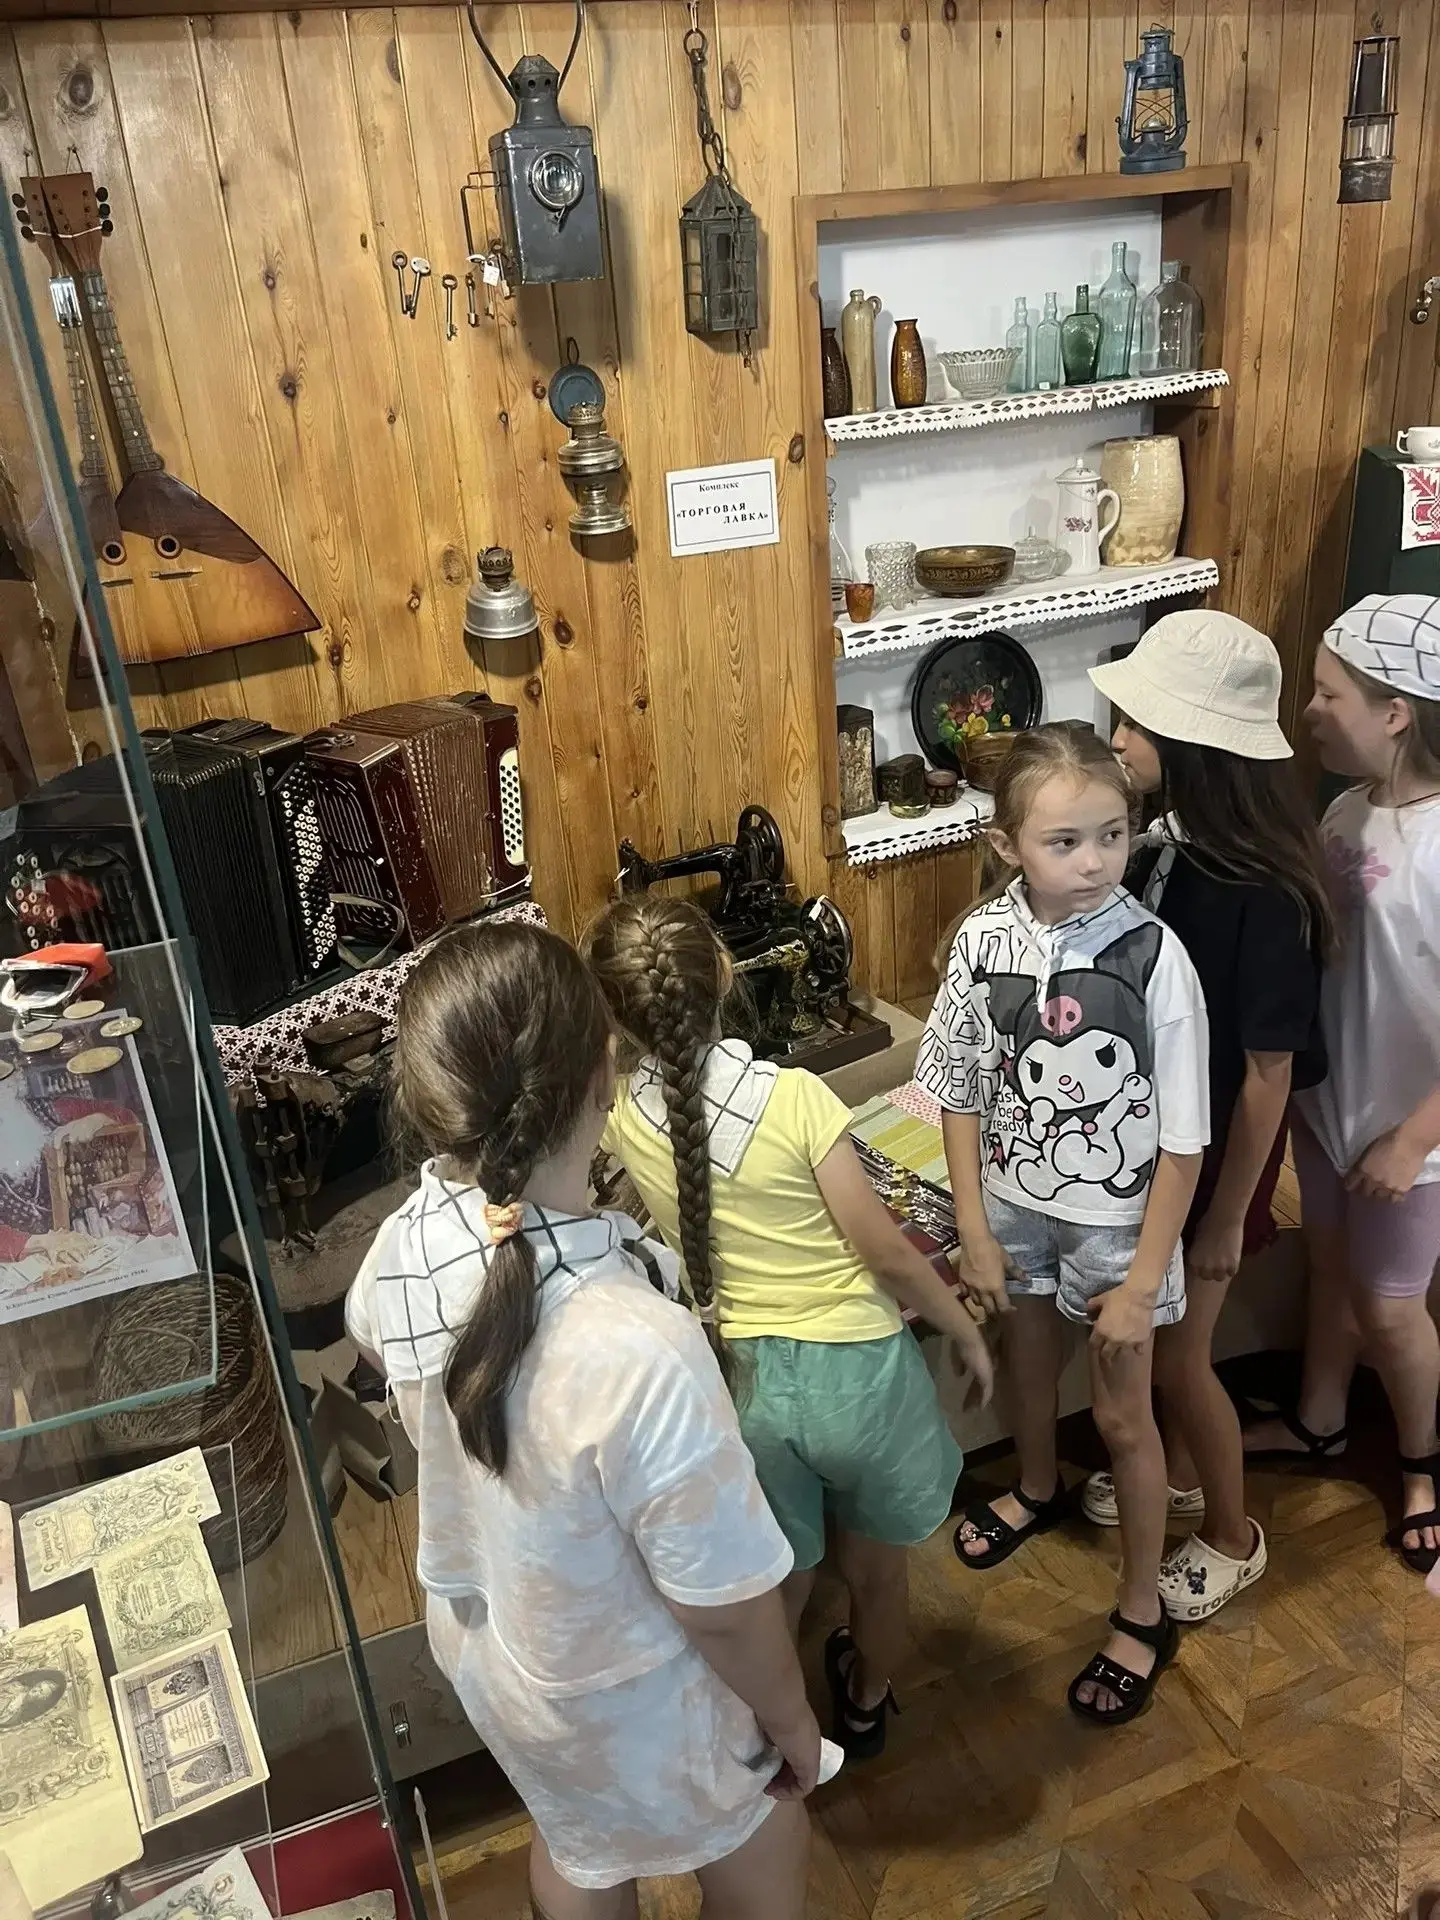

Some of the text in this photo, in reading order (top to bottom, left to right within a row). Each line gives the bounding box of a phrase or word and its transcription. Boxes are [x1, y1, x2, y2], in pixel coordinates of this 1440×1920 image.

[676, 502, 746, 518] «ТОРГОВАЯ
[723, 512, 768, 524] ЛАВКА»
[998, 1104, 1012, 1118] be
[993, 1118, 1024, 1135] ready
